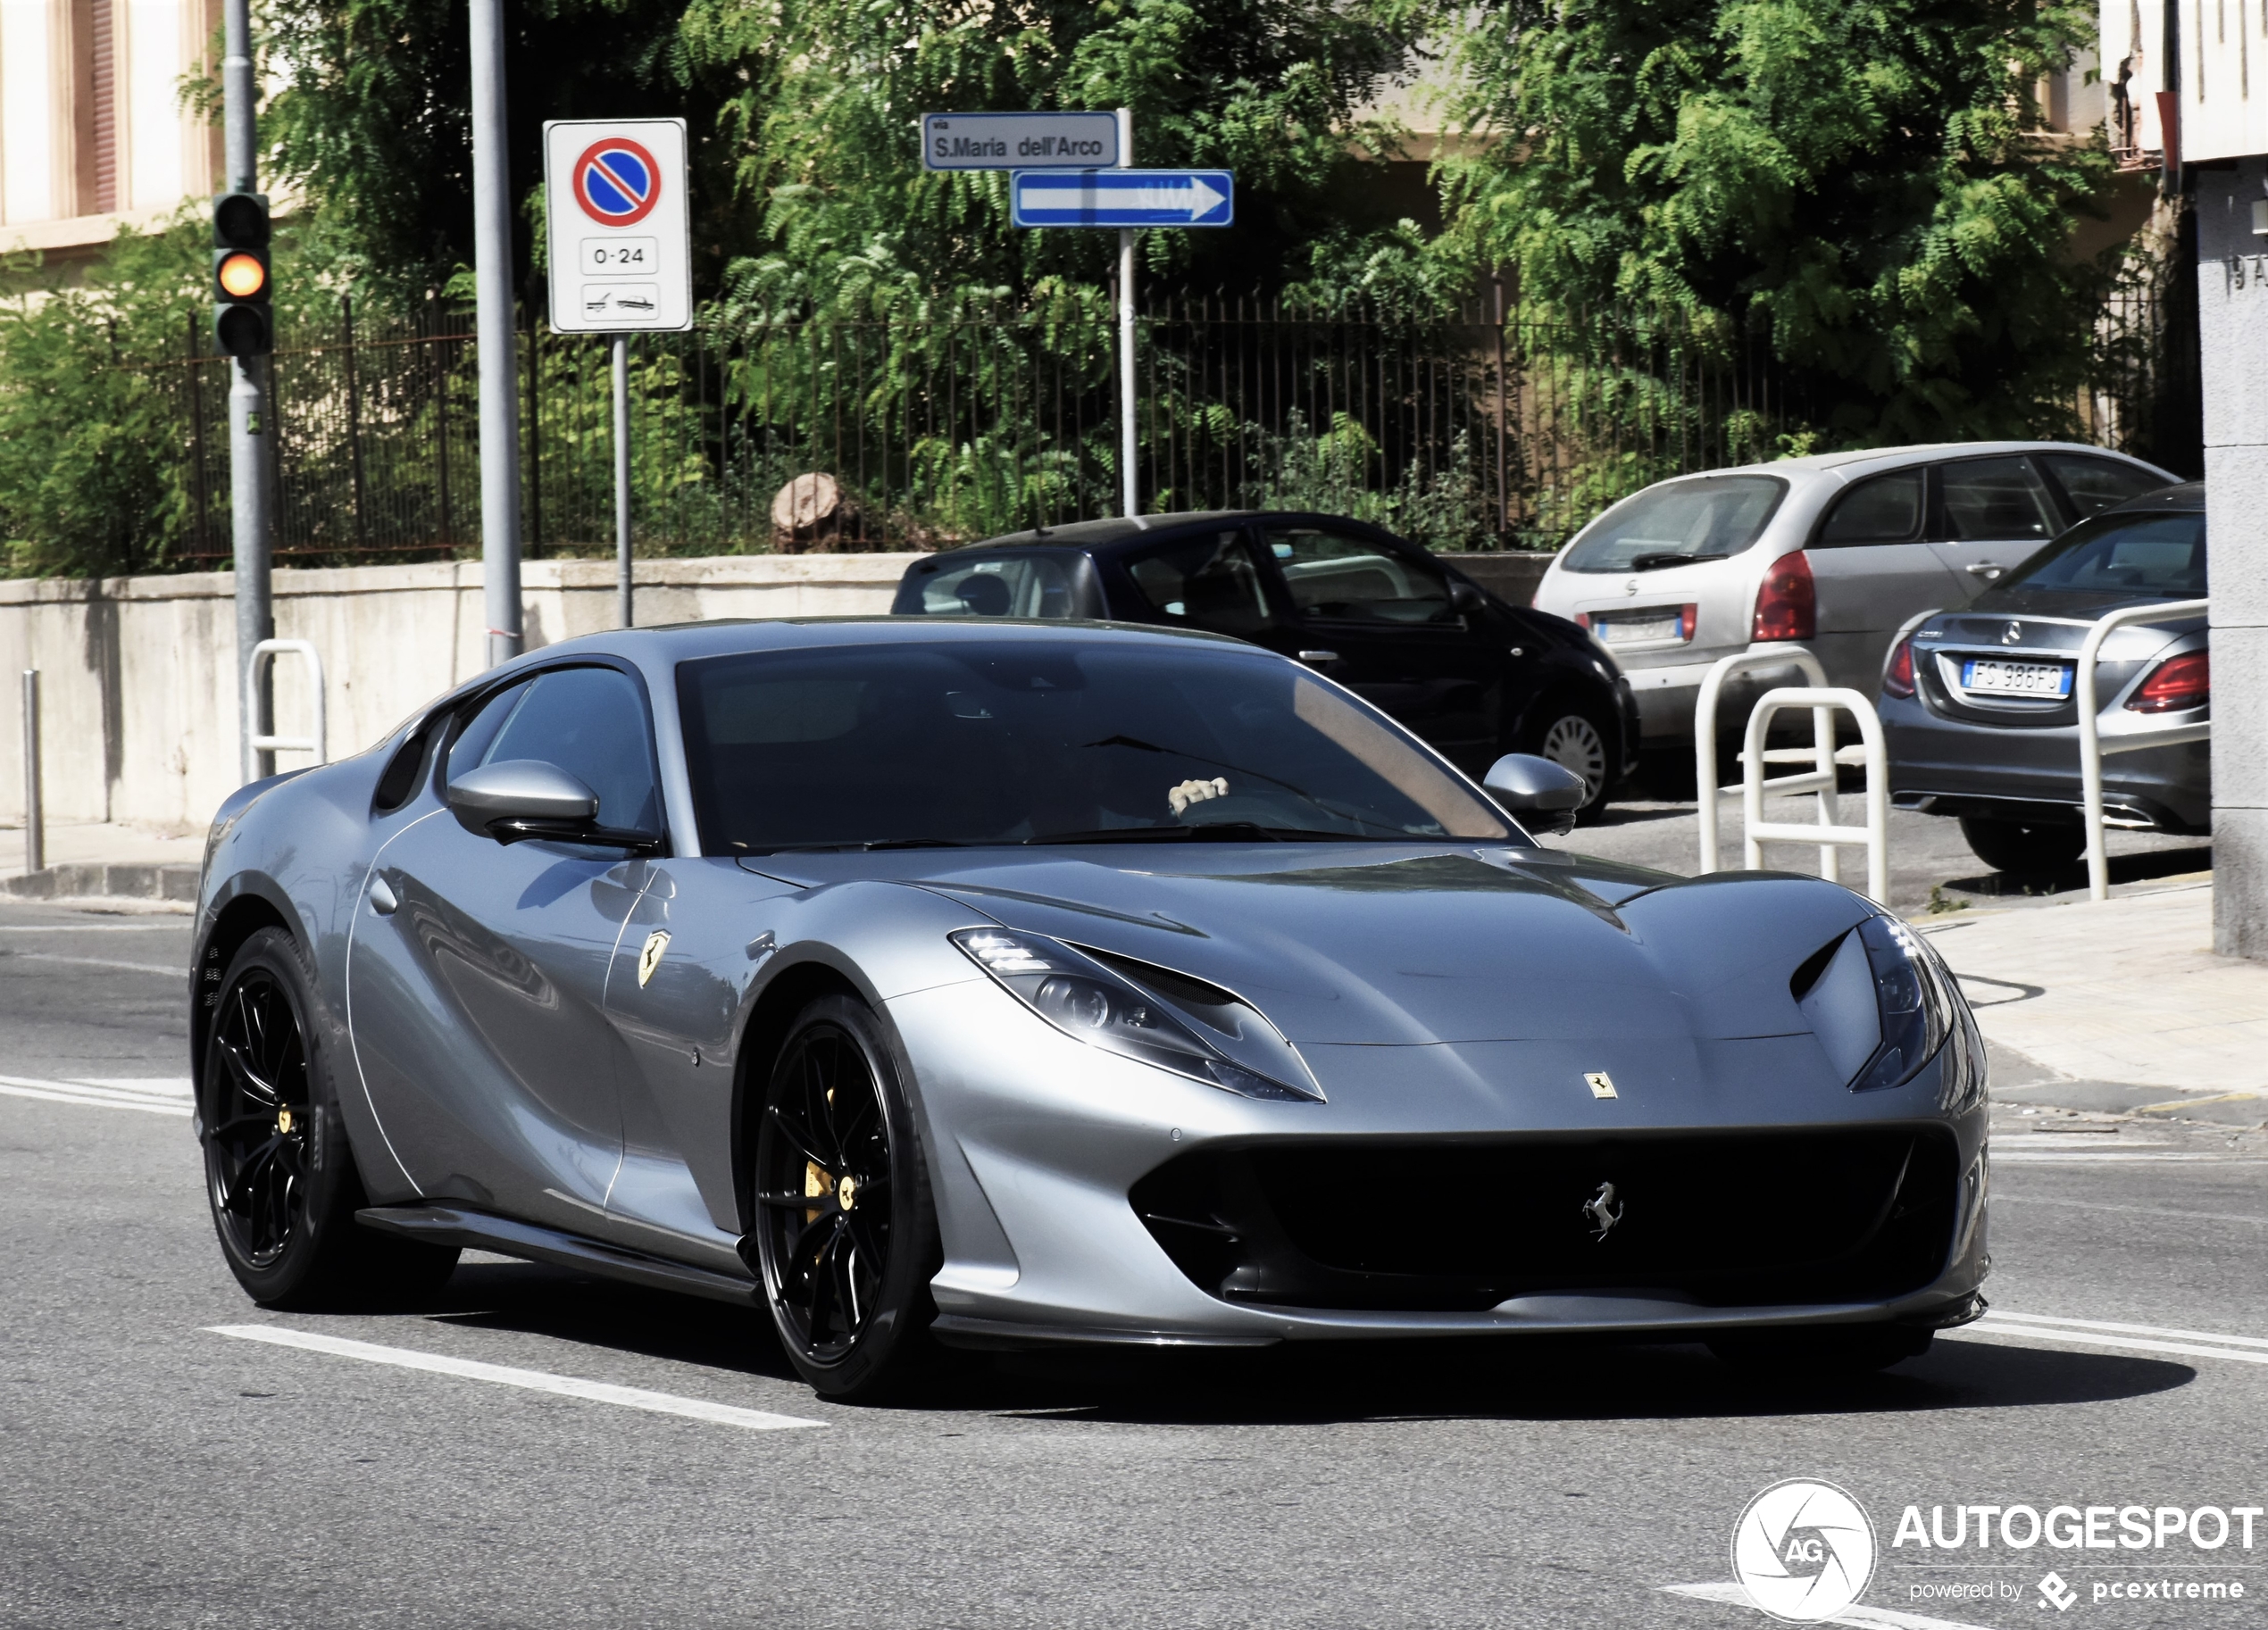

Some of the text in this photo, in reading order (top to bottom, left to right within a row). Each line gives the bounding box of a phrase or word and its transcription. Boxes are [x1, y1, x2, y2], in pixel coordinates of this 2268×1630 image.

[933, 120, 948, 129] via
[935, 136, 1103, 158] S.Maria dell'Arco
